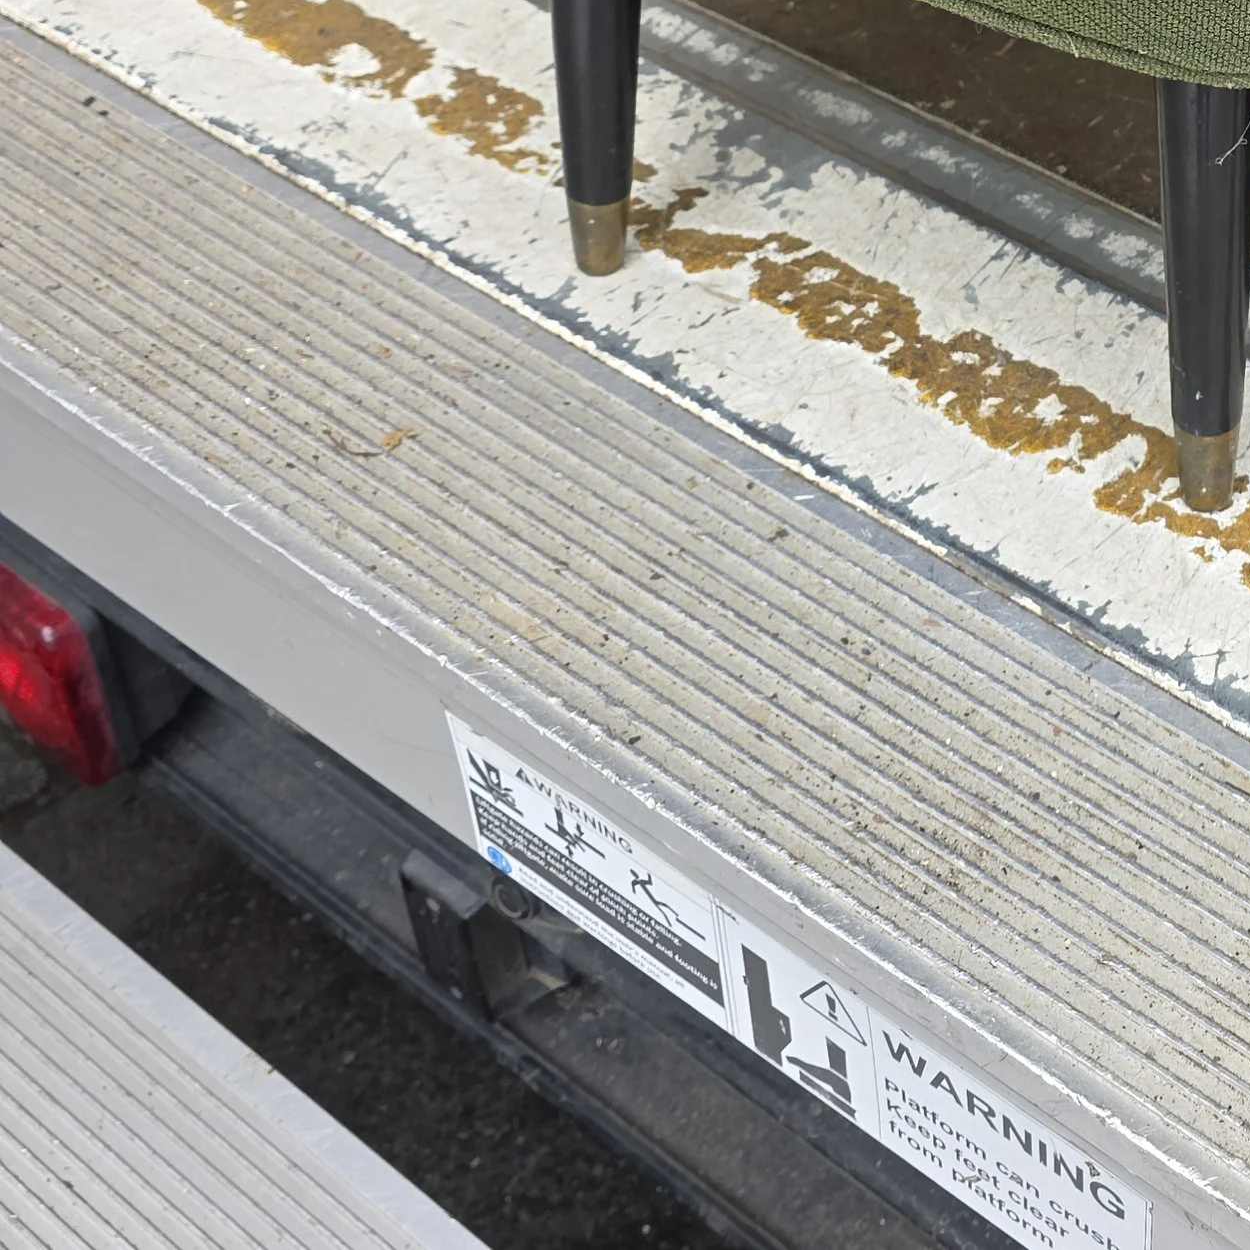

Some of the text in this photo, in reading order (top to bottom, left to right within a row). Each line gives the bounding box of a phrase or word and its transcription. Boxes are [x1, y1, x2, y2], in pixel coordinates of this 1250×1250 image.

[533, 777, 633, 854] WARNING
[882, 1030, 1125, 1220] WARNING
[884, 1077, 1120, 1250] Platform can crush
[887, 1098, 1069, 1238] Keep feet clear
[889, 1120, 1054, 1249] from platform
